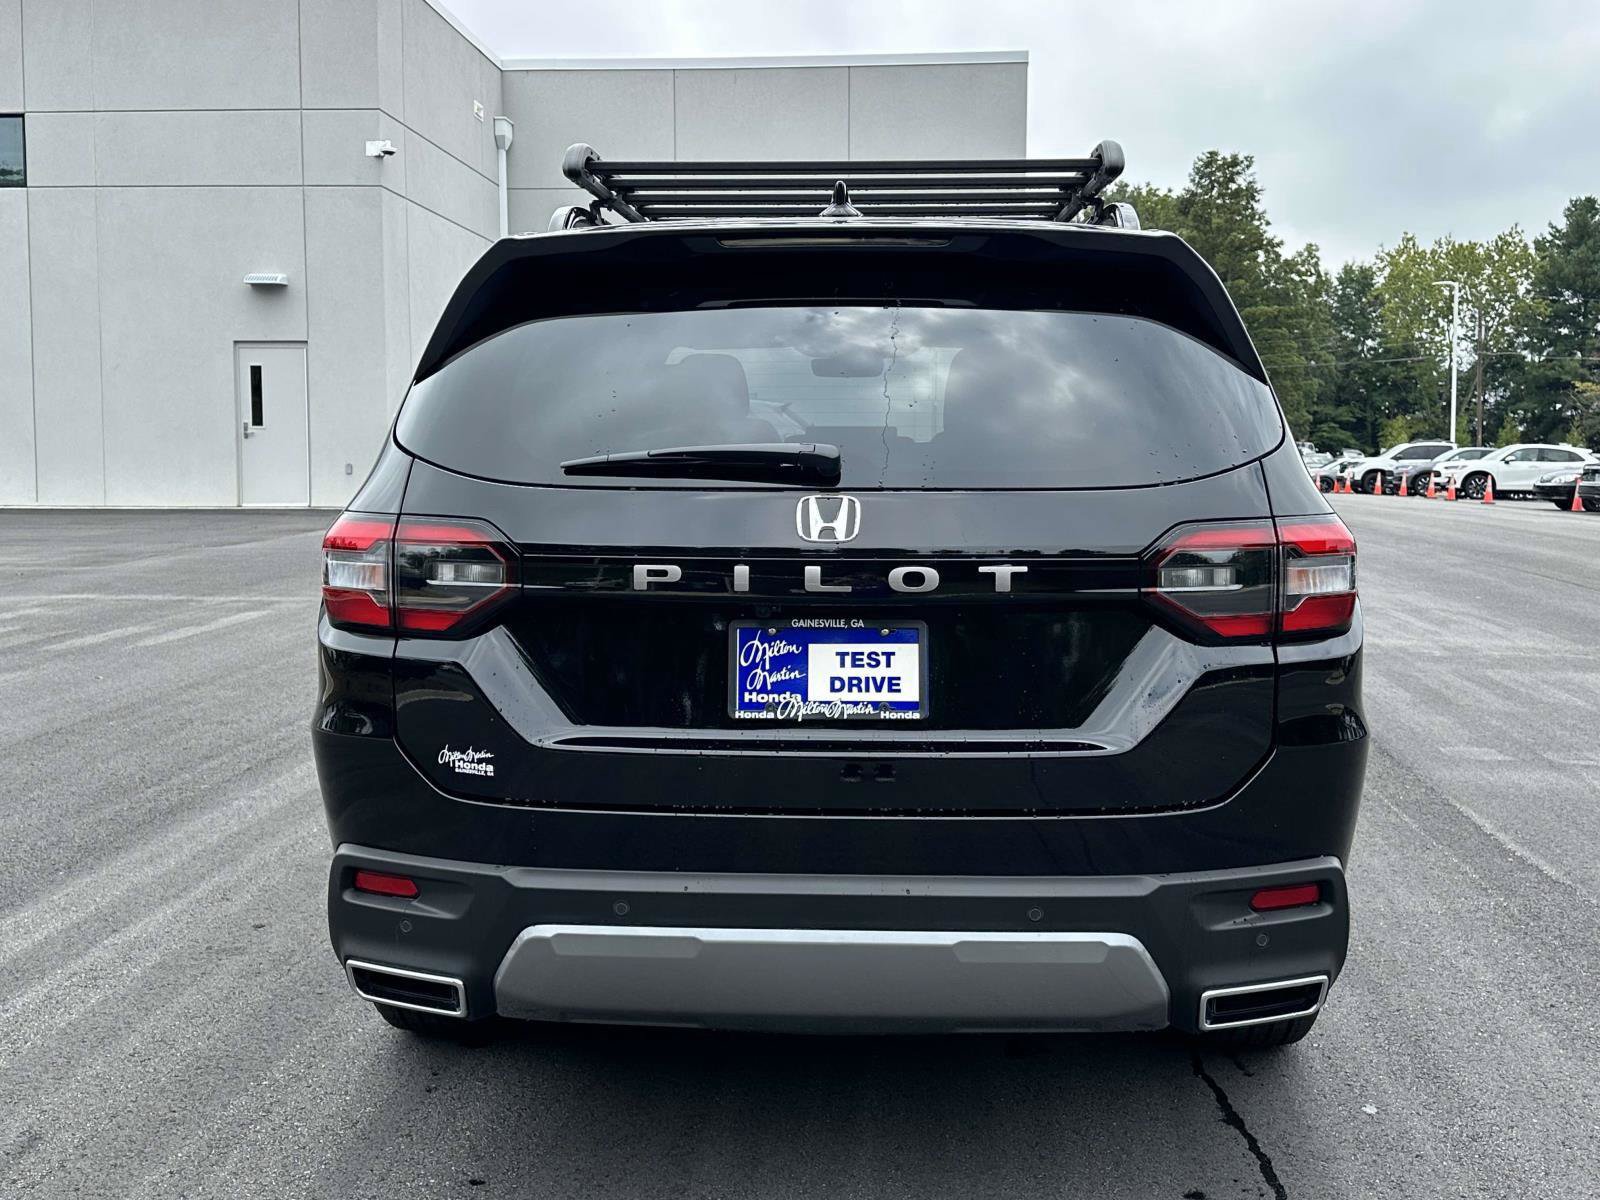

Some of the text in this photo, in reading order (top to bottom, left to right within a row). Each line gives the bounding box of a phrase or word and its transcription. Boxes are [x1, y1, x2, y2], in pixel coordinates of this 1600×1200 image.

[633, 564, 1028, 593] PILOT
[791, 618, 864, 629] GAINESVILLE, GA
[740, 629, 802, 669] Milton
[835, 651, 896, 668] TEST
[746, 661, 806, 691] Martin
[829, 676, 902, 693] DRIVE
[744, 692, 802, 703] Honda
[735, 699, 921, 722] Honda Milton Martin Honda
[455, 760, 494, 772] Honda
